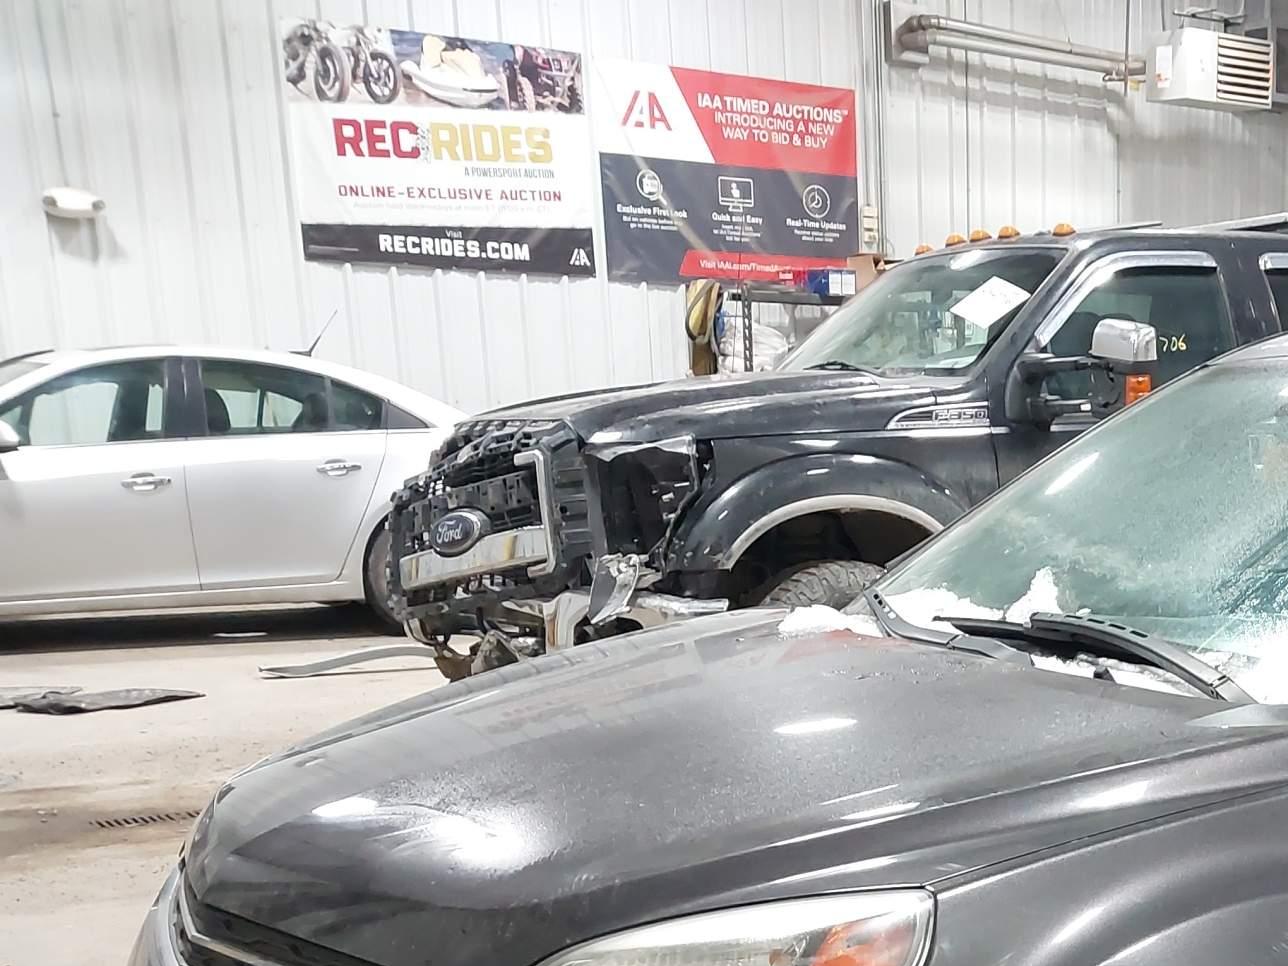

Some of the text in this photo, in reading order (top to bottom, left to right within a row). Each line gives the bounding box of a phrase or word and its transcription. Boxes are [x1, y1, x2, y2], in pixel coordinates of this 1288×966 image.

[698, 93, 723, 110] IAA
[724, 96, 769, 114] TIMED
[715, 111, 835, 136] INTRODUCING A NEW
[332, 118, 553, 164] REC RIDES
[722, 126, 828, 149] WAY TO BID & BUY
[464, 166, 555, 179] A POWERSPORT AUCTION
[338, 184, 562, 201] ONLINE-EXCLUSIVE AUCTION
[616, 203, 652, 215] Exclusive
[653, 207, 669, 216] First
[712, 212, 763, 225] Quick and Easy
[786, 218, 847, 231] Real-Time Updates
[378, 234, 531, 261] RECRIDES.COM
[699, 259, 716, 269] Visit
[1159, 333, 1187, 352] 706
[436, 520, 463, 544] Ford
